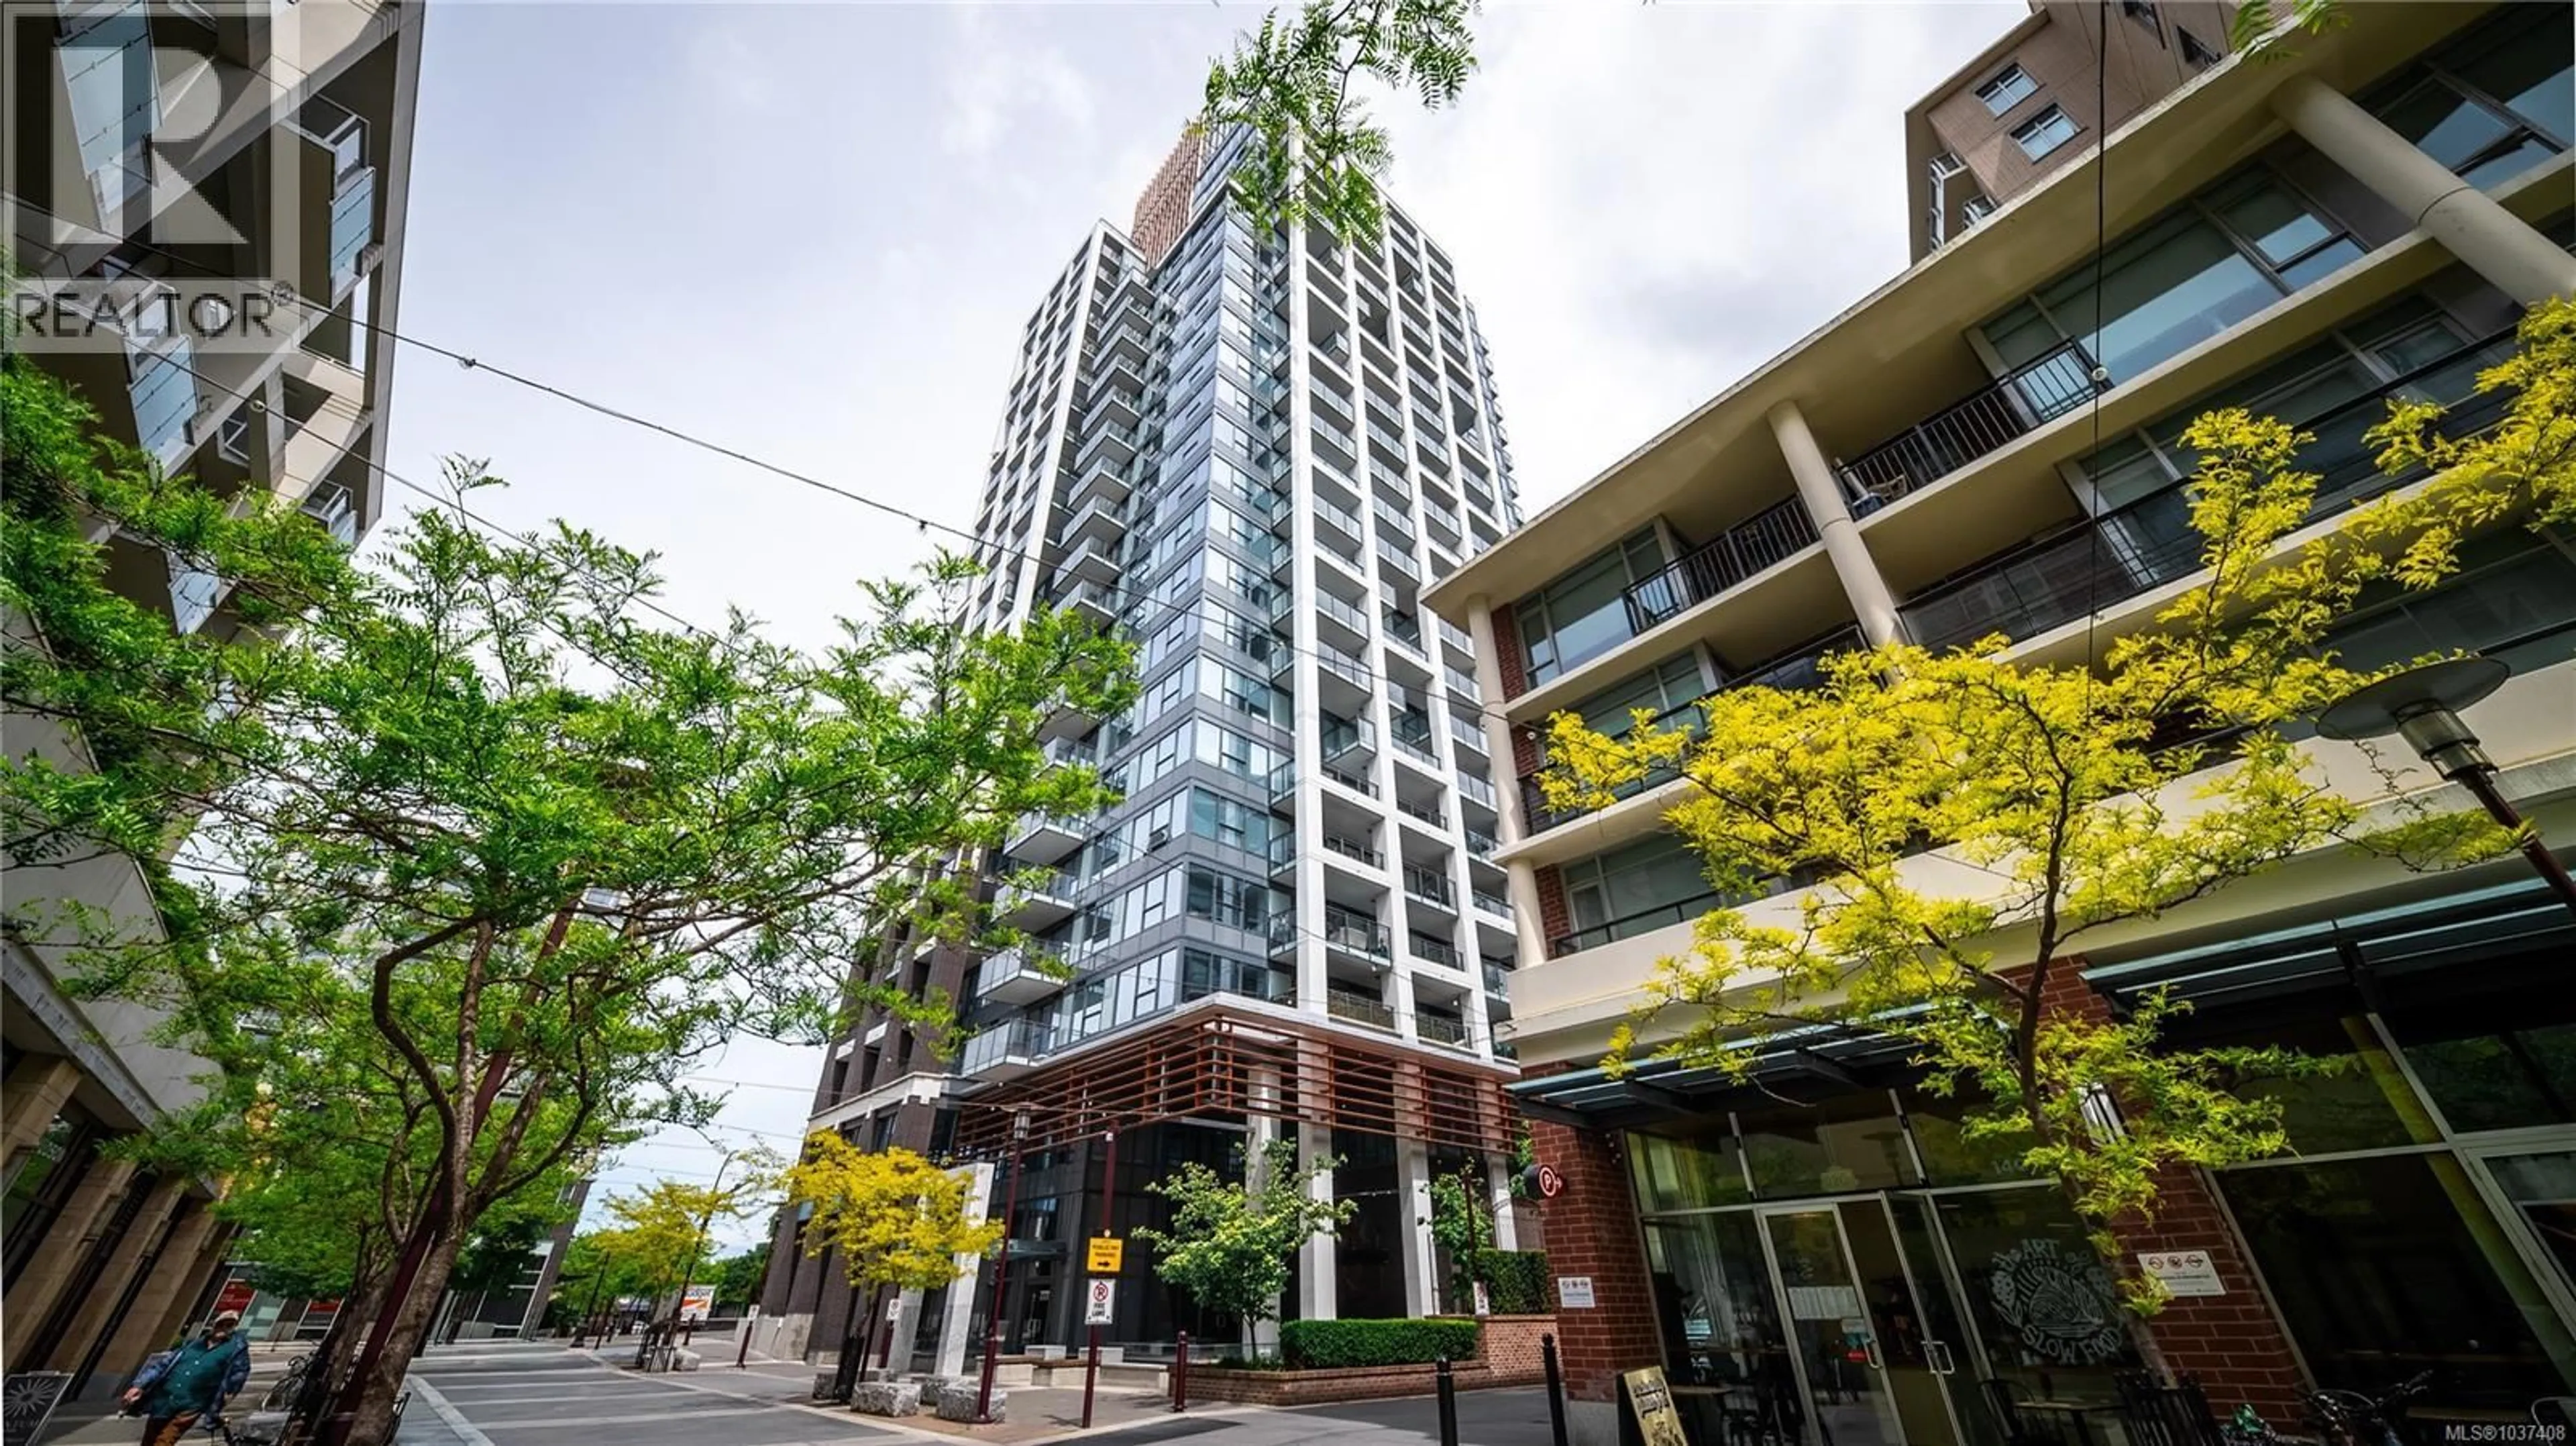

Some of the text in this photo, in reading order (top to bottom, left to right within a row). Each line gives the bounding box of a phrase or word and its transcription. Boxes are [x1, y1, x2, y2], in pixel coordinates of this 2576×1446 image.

[2021, 1239, 2060, 1260] ART
[2021, 1323, 2123, 1366] SLOW FOOD
